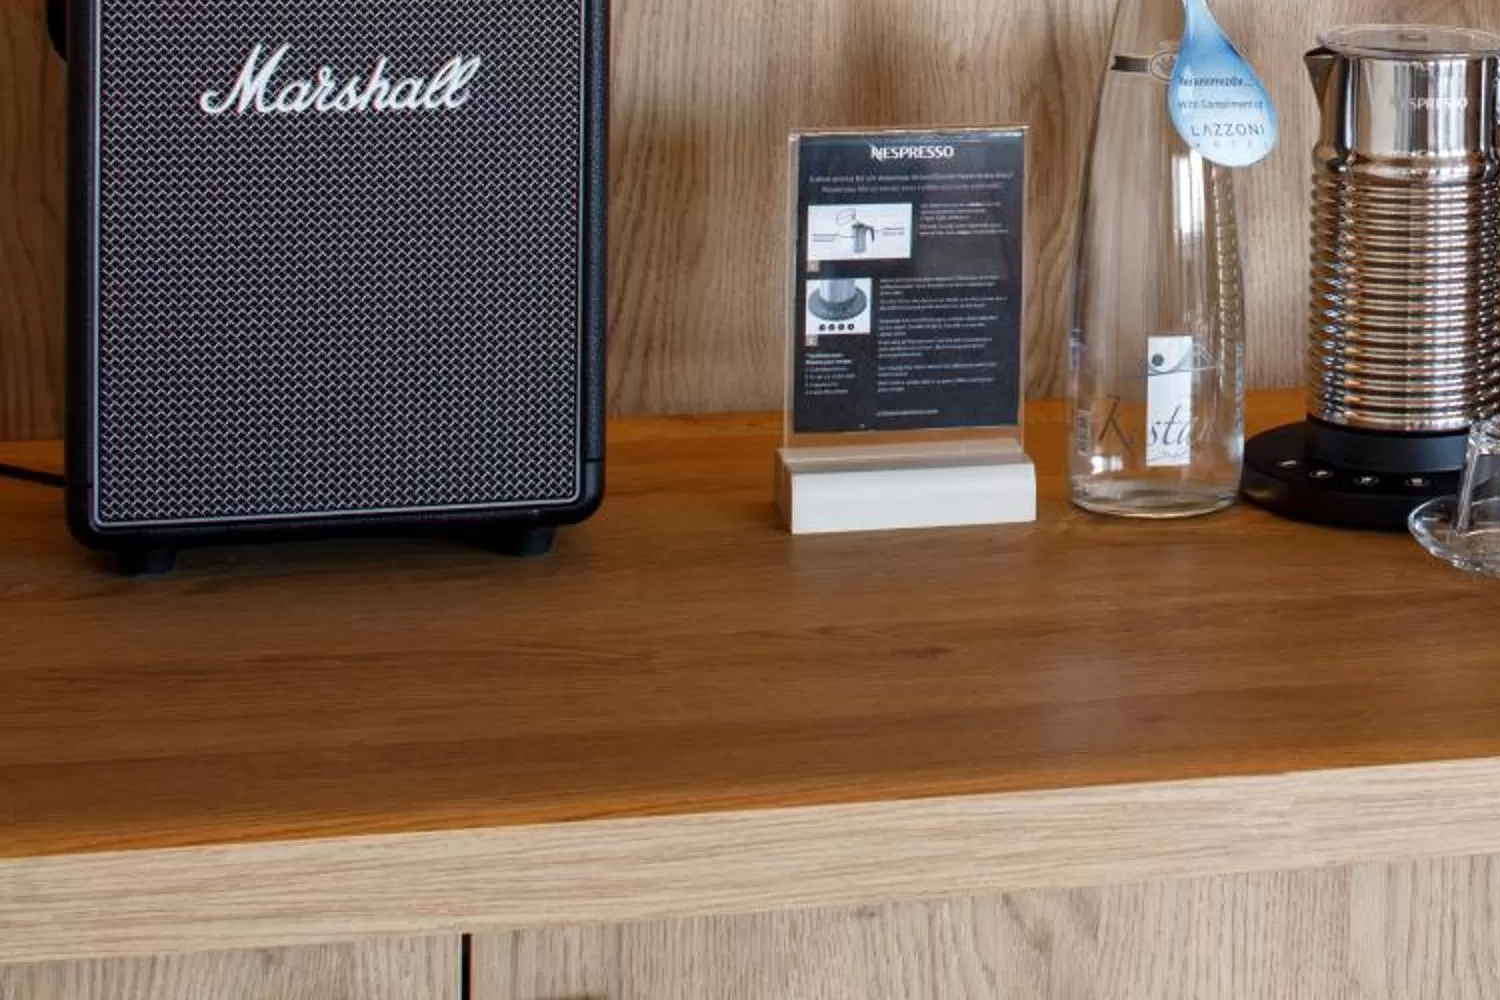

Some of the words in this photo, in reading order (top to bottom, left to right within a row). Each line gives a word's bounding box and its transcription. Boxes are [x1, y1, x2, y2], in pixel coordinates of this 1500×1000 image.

[200, 43, 481, 113] Marshall
[1191, 123, 1265, 136] LAZZONI
[871, 146, 955, 161] NESPRESSO
